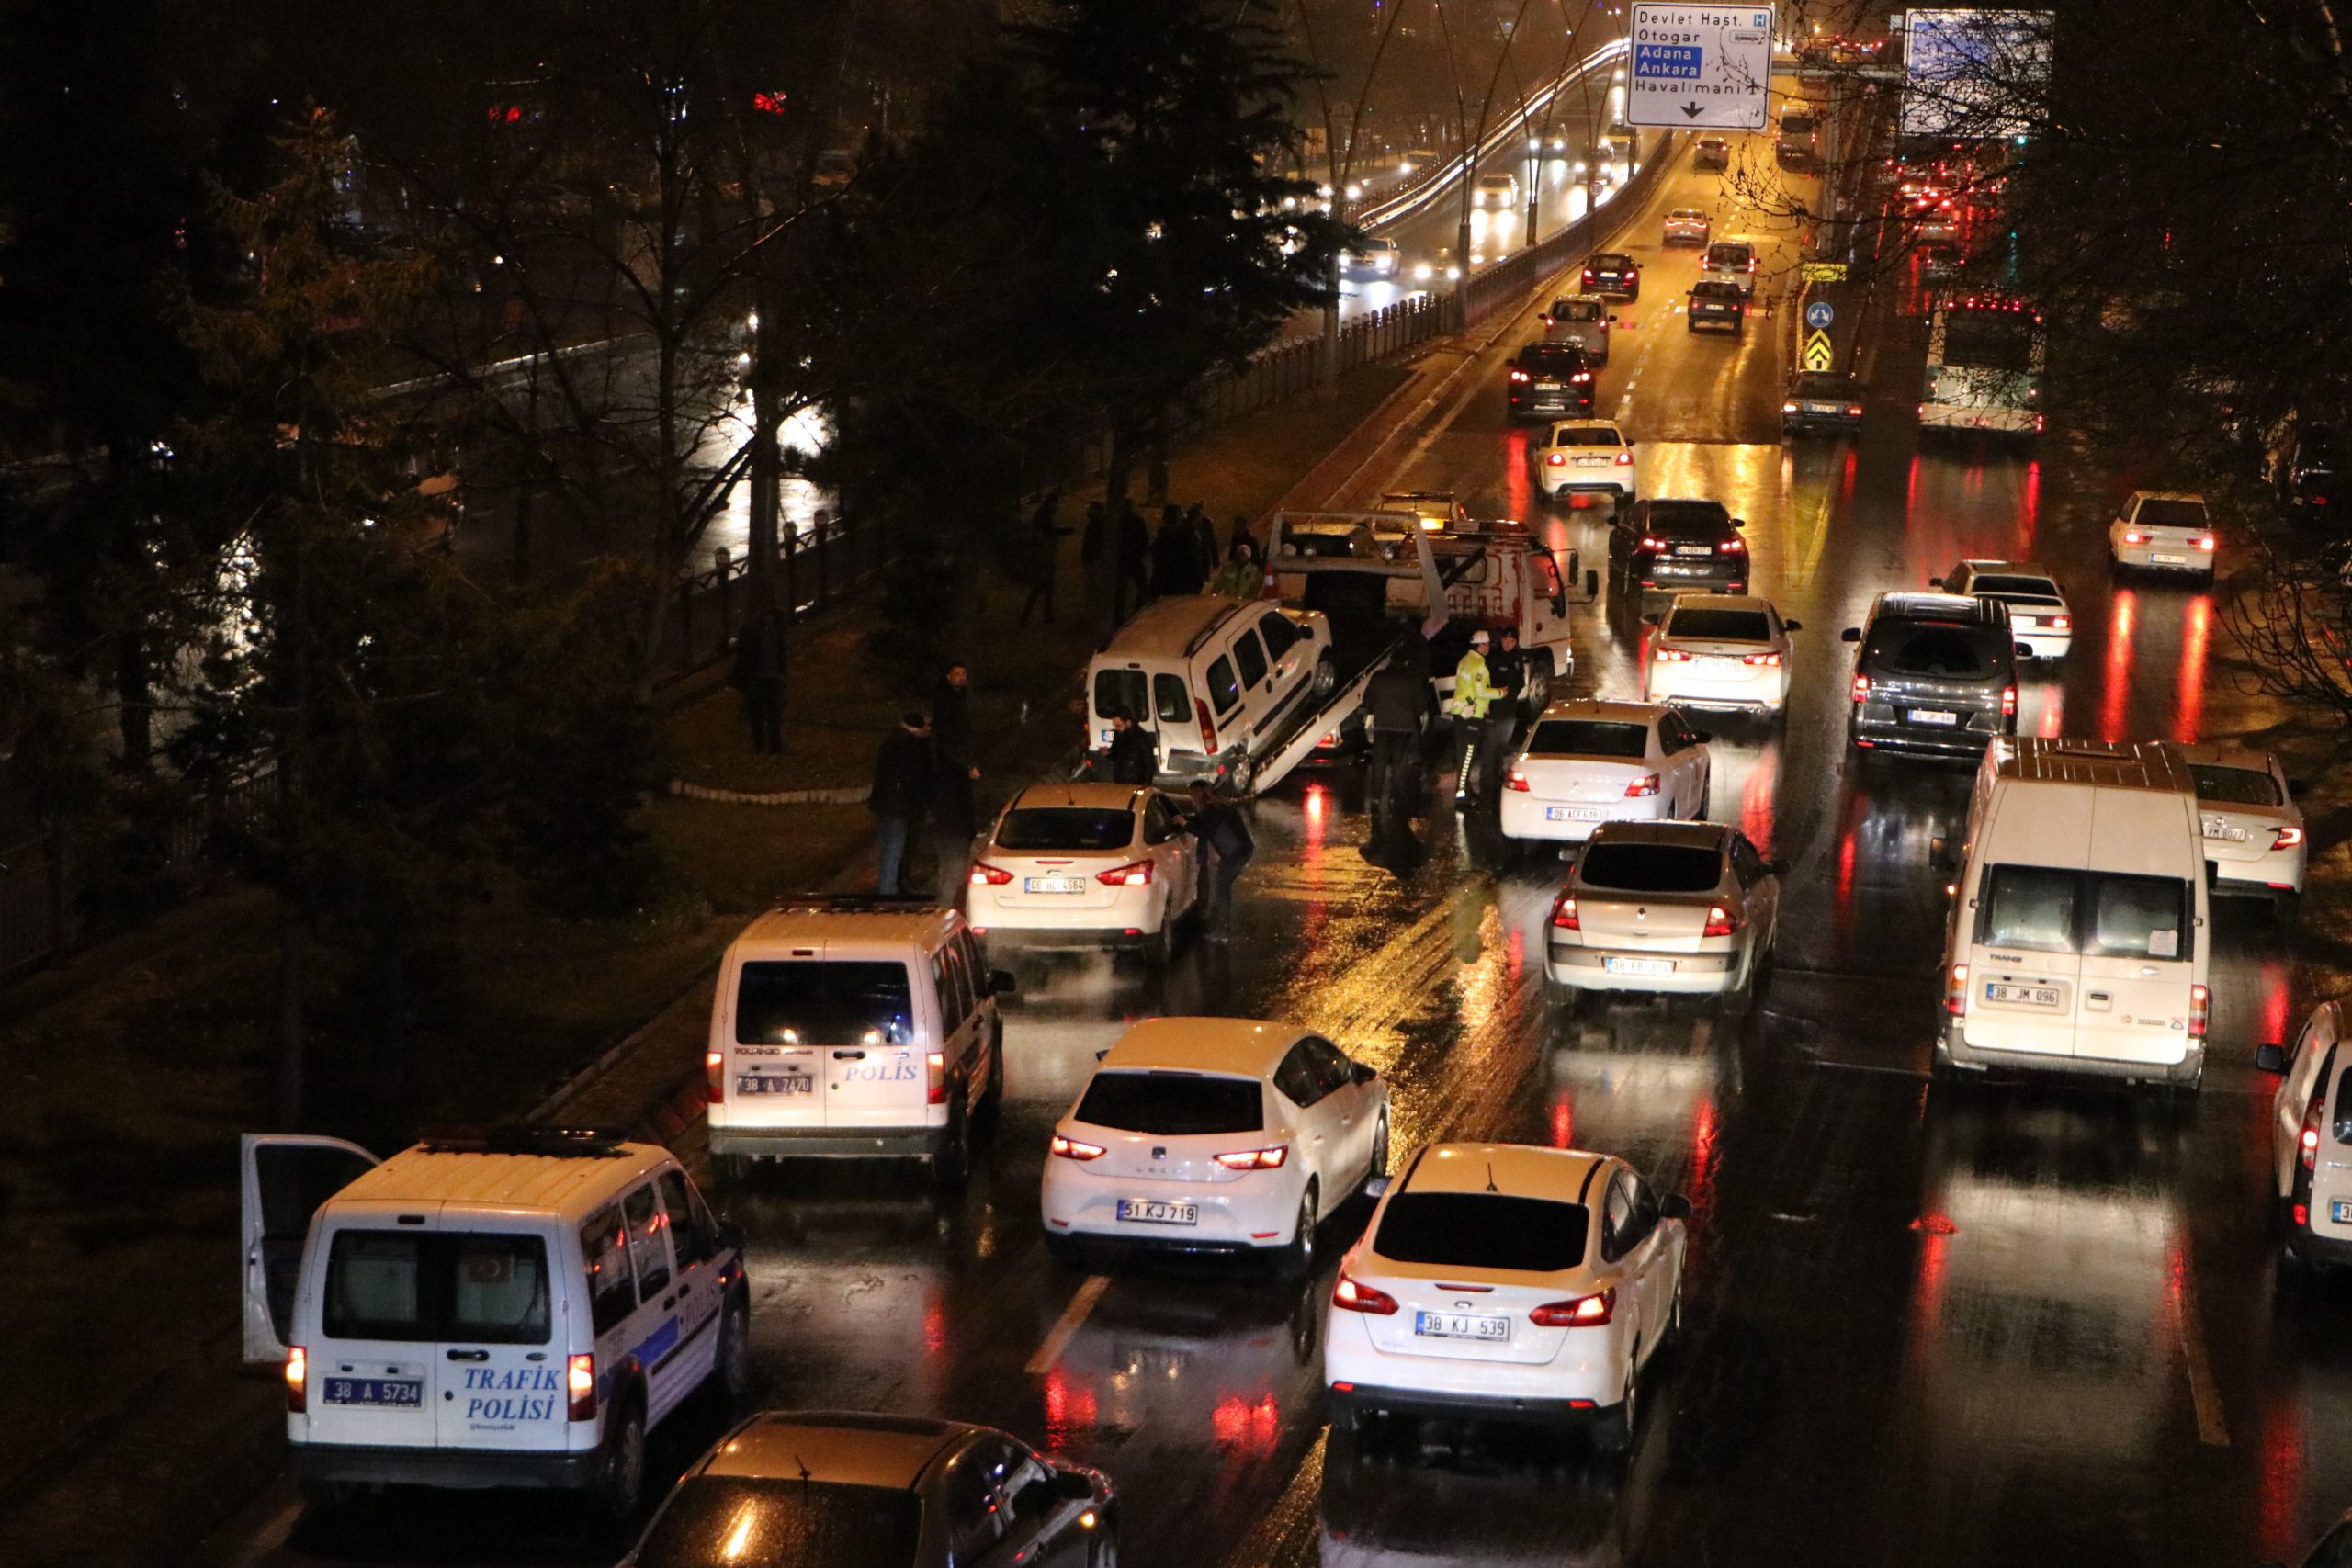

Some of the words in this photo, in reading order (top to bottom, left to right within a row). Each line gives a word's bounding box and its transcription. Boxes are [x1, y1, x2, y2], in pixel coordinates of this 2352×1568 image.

[1639, 11, 1693, 26] Devlet
[1701, 12, 1742, 27] Hast.
[1639, 29, 1701, 44] Otogar
[1640, 46, 1691, 61] Adana
[1639, 62, 1698, 76] Ankara
[1995, 987, 2007, 998] 38
[2017, 988, 2030, 1000] JM
[2036, 990, 2055, 1002] 096
[844, 1061, 918, 1082] POLİS
[744, 1077, 759, 1091] 38
[766, 1078, 775, 1091] A
[1125, 1203, 1140, 1216] 51
[1145, 1204, 1165, 1218] KJ
[1170, 1206, 1194, 1221] 719
[1425, 1315, 1442, 1331] 38
[1452, 1317, 1469, 1333] KJ
[1479, 1320, 1505, 1336] 539
[464, 1364, 560, 1390] TRAFİK
[334, 1381, 353, 1398] 38
[363, 1382, 373, 1399] A
[382, 1383, 418, 1401] 5734
[466, 1393, 557, 1420] POLİSİ
